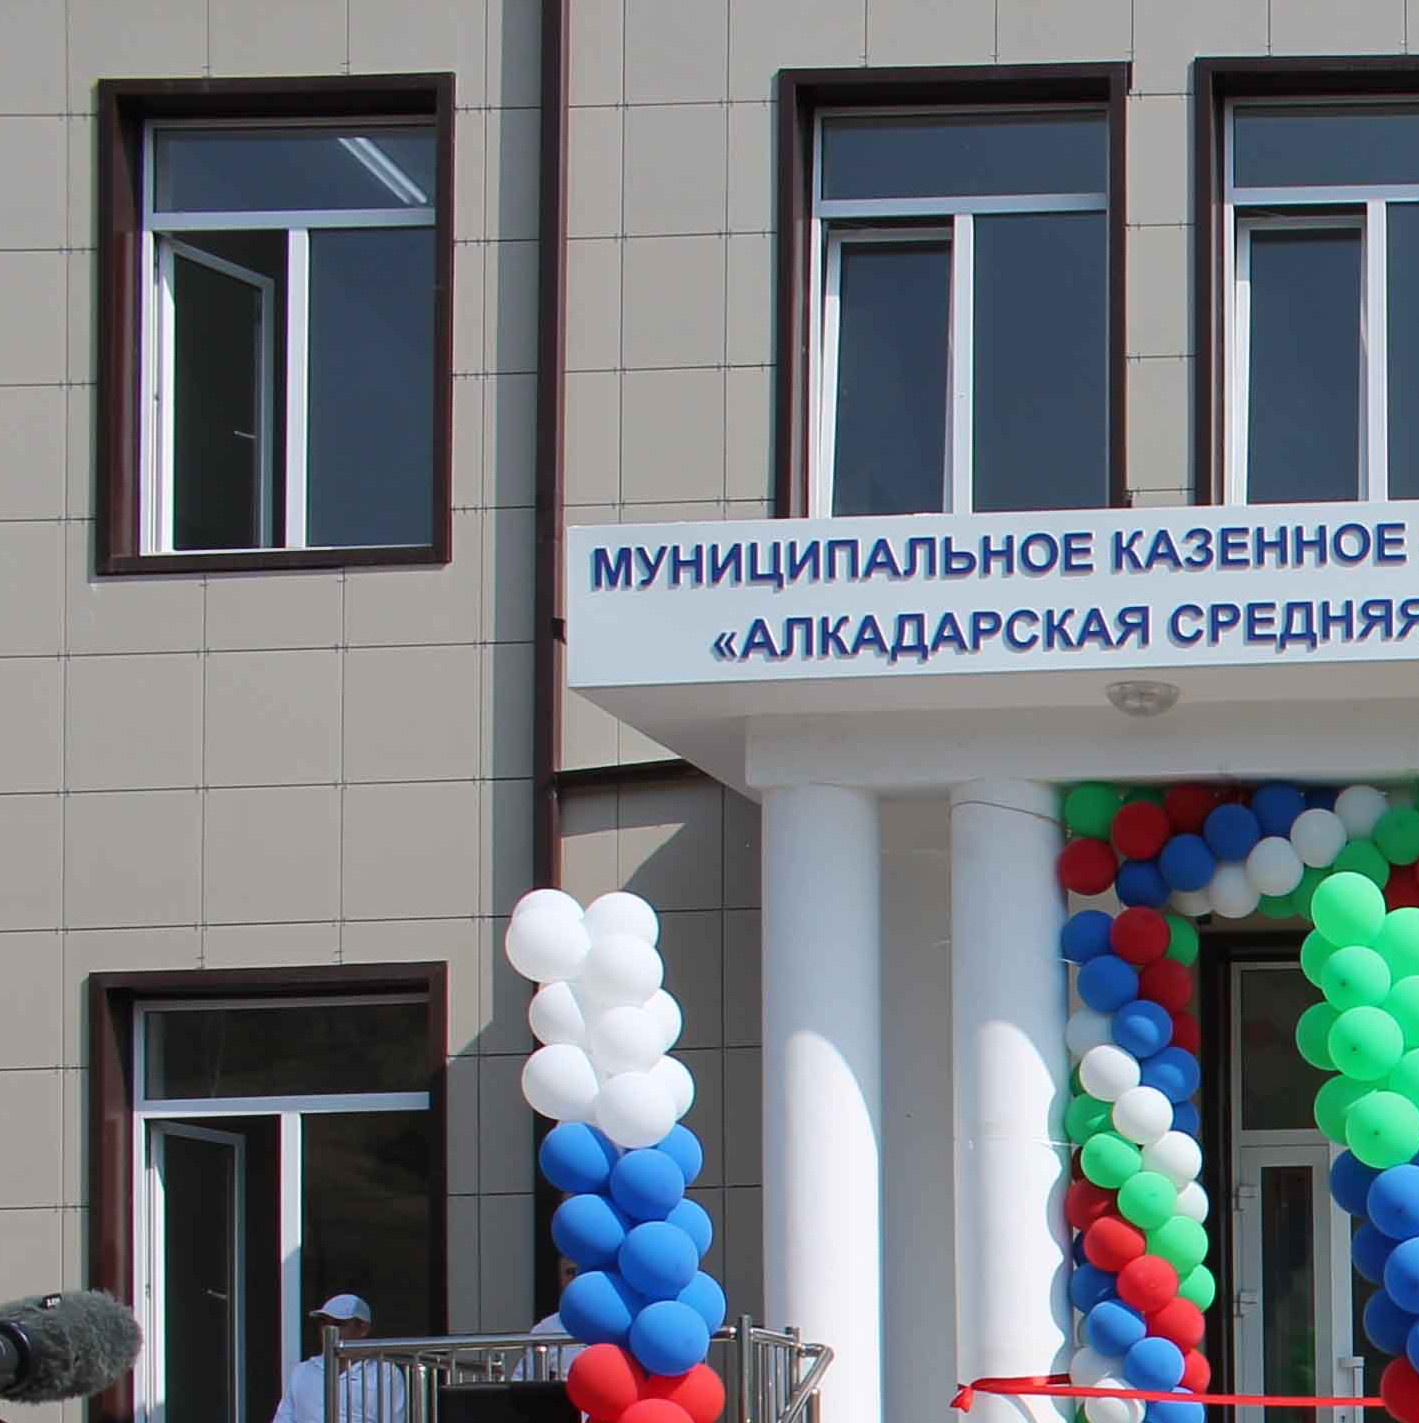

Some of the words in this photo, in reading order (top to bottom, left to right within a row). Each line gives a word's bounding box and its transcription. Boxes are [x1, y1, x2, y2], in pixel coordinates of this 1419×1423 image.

[591, 530, 1092, 588] МУНИЦИПАЛЬНОЕ
[1112, 521, 1407, 570] КАЗЕННОЕ
[711, 605, 1148, 661] «АЛКАДАРСКАЯ
